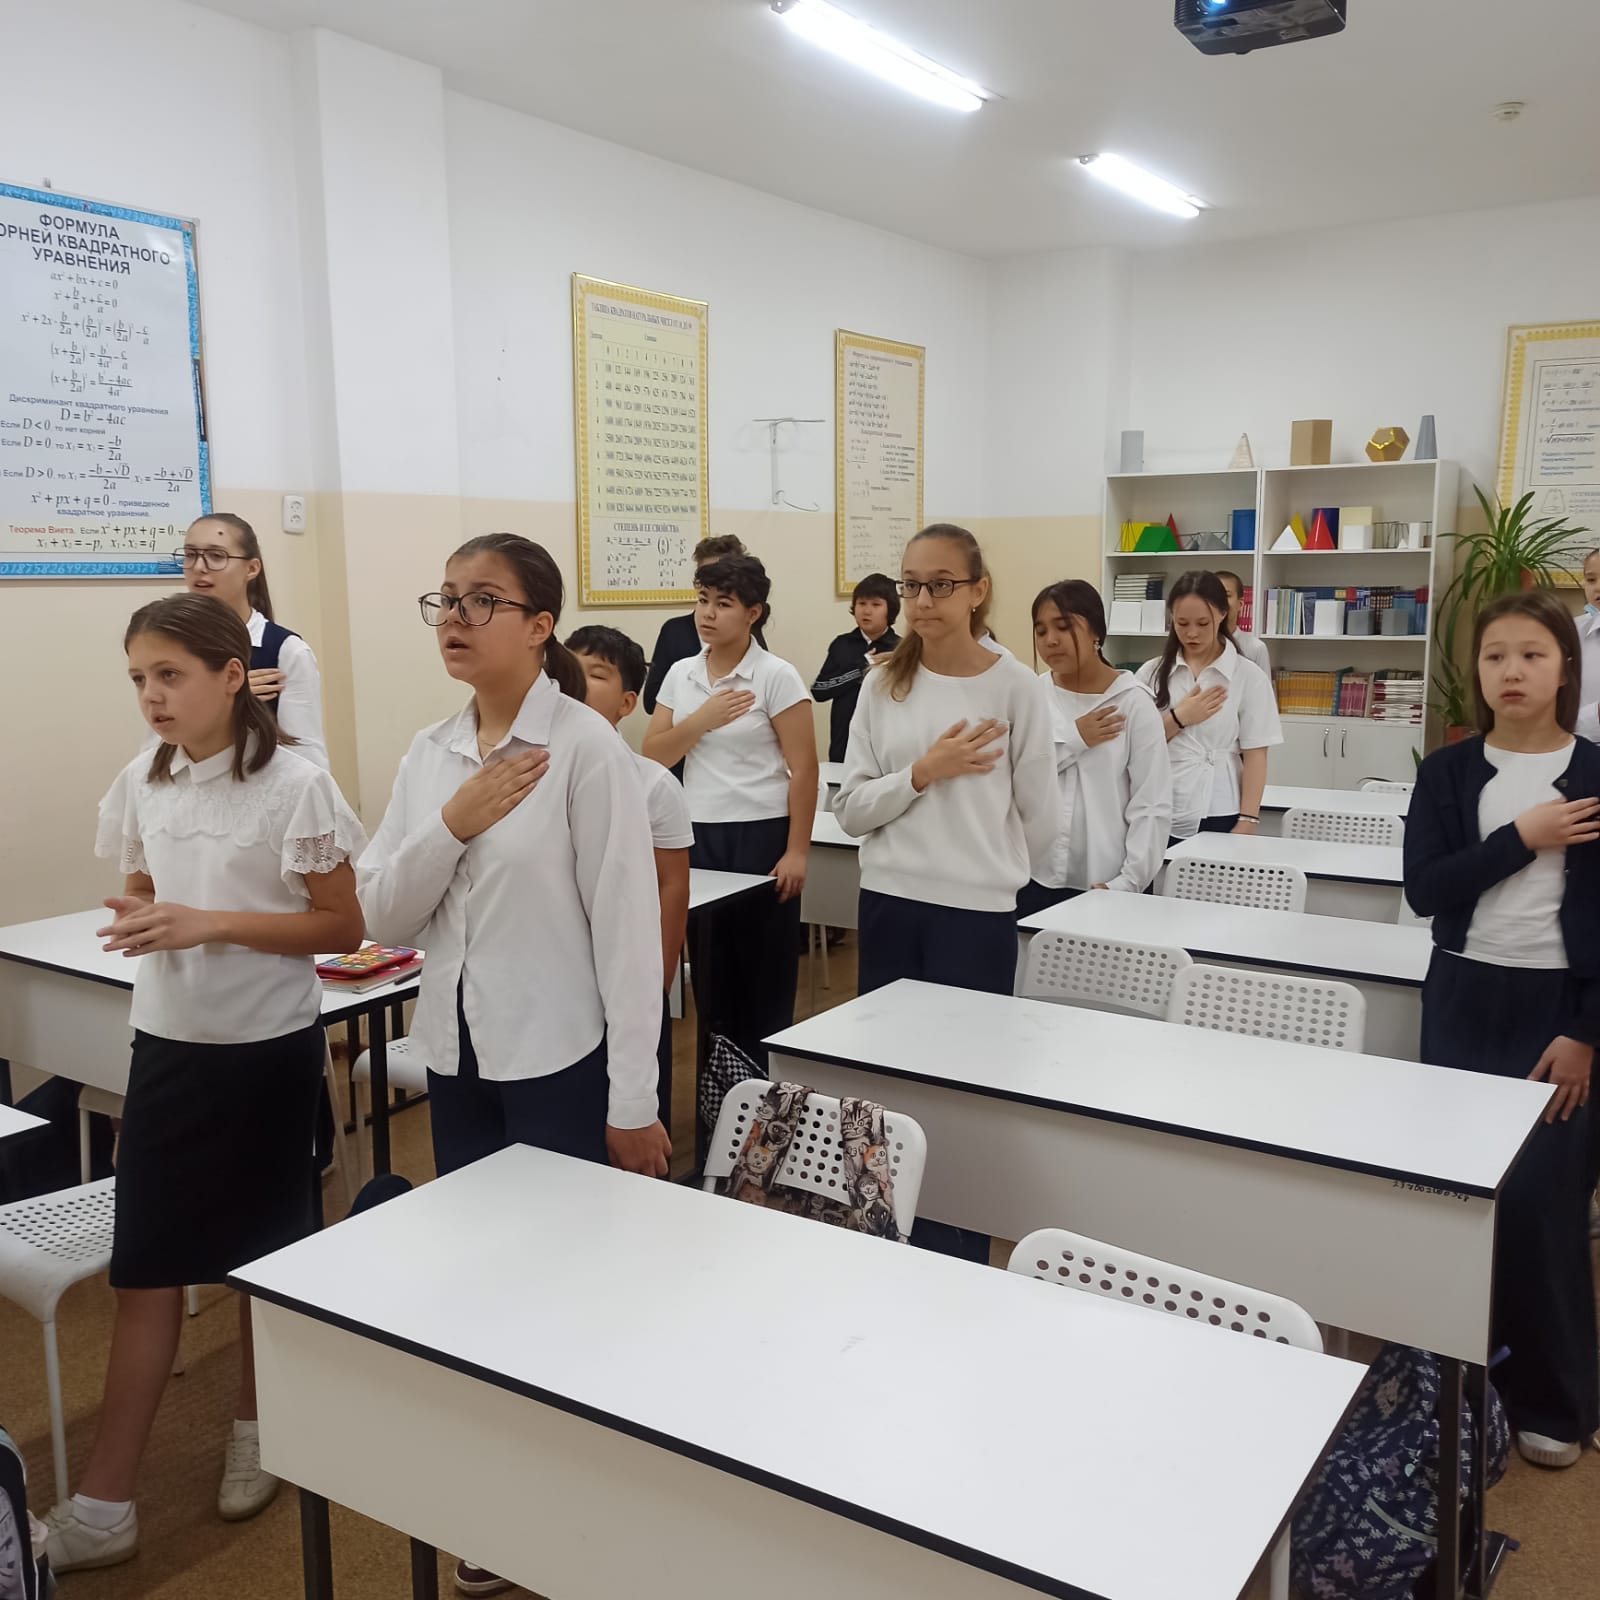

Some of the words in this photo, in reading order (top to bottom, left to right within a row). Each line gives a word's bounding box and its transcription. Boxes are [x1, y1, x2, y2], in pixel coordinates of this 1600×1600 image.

[39, 213, 120, 241] ФОРМУЛА
[32, 246, 131, 275] УРАВНЕНИЯ
[57, 233, 171, 265] КВАДРАТНОГО
[9, 393, 73, 407] Дискриминант
[8, 524, 46, 535] Теорема
